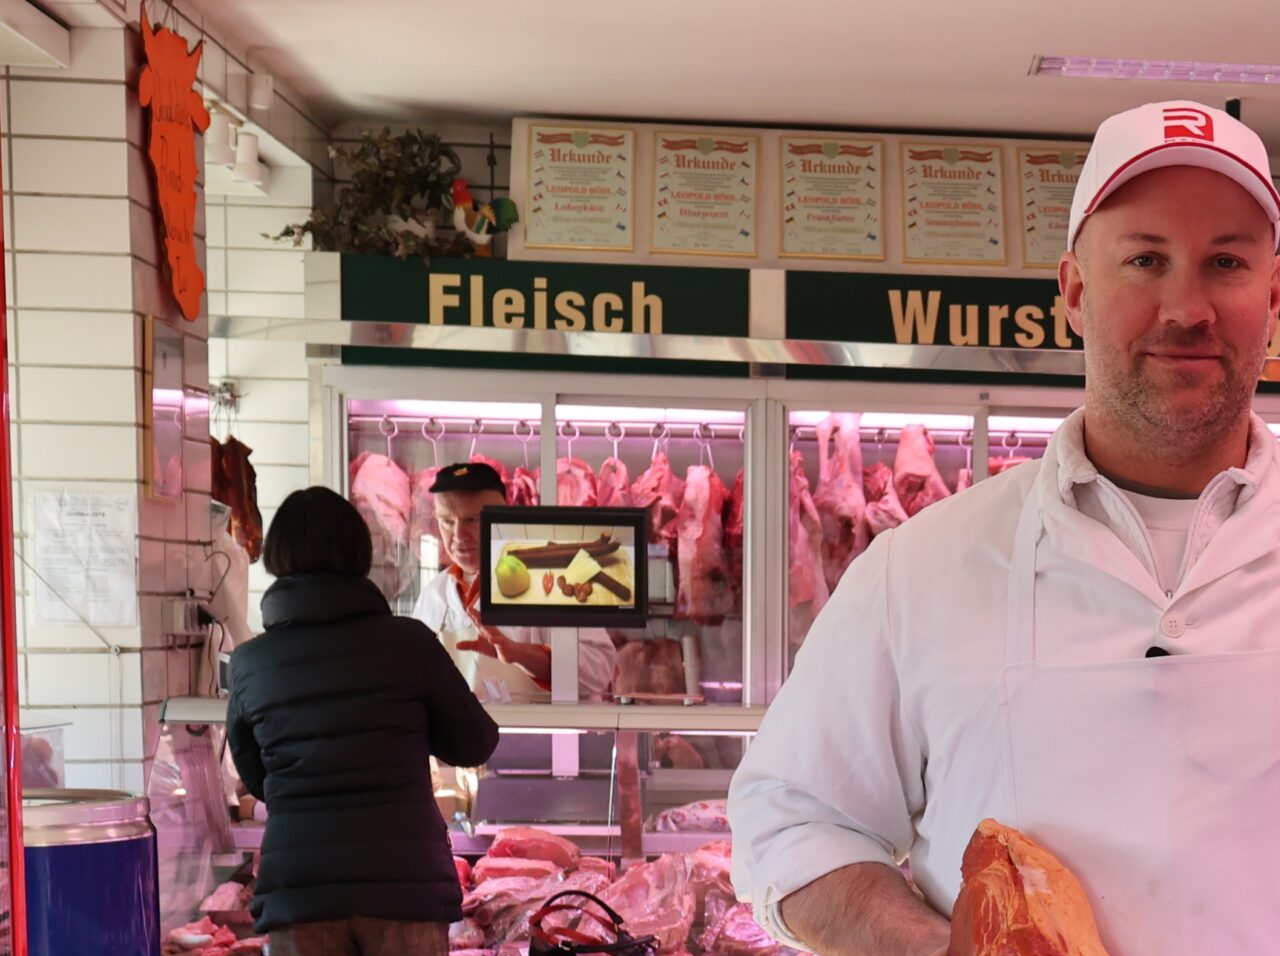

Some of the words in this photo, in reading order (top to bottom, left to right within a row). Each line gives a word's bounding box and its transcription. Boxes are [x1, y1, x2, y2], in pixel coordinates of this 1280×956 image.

[550, 147, 613, 164] Urkunde
[673, 154, 737, 171] Urkunde
[800, 159, 862, 174] Urkunde
[921, 164, 982, 180] Urkunde
[1038, 168, 1080, 184] Urkun
[428, 272, 664, 335] Fleisch
[887, 289, 1074, 348] Wurst
